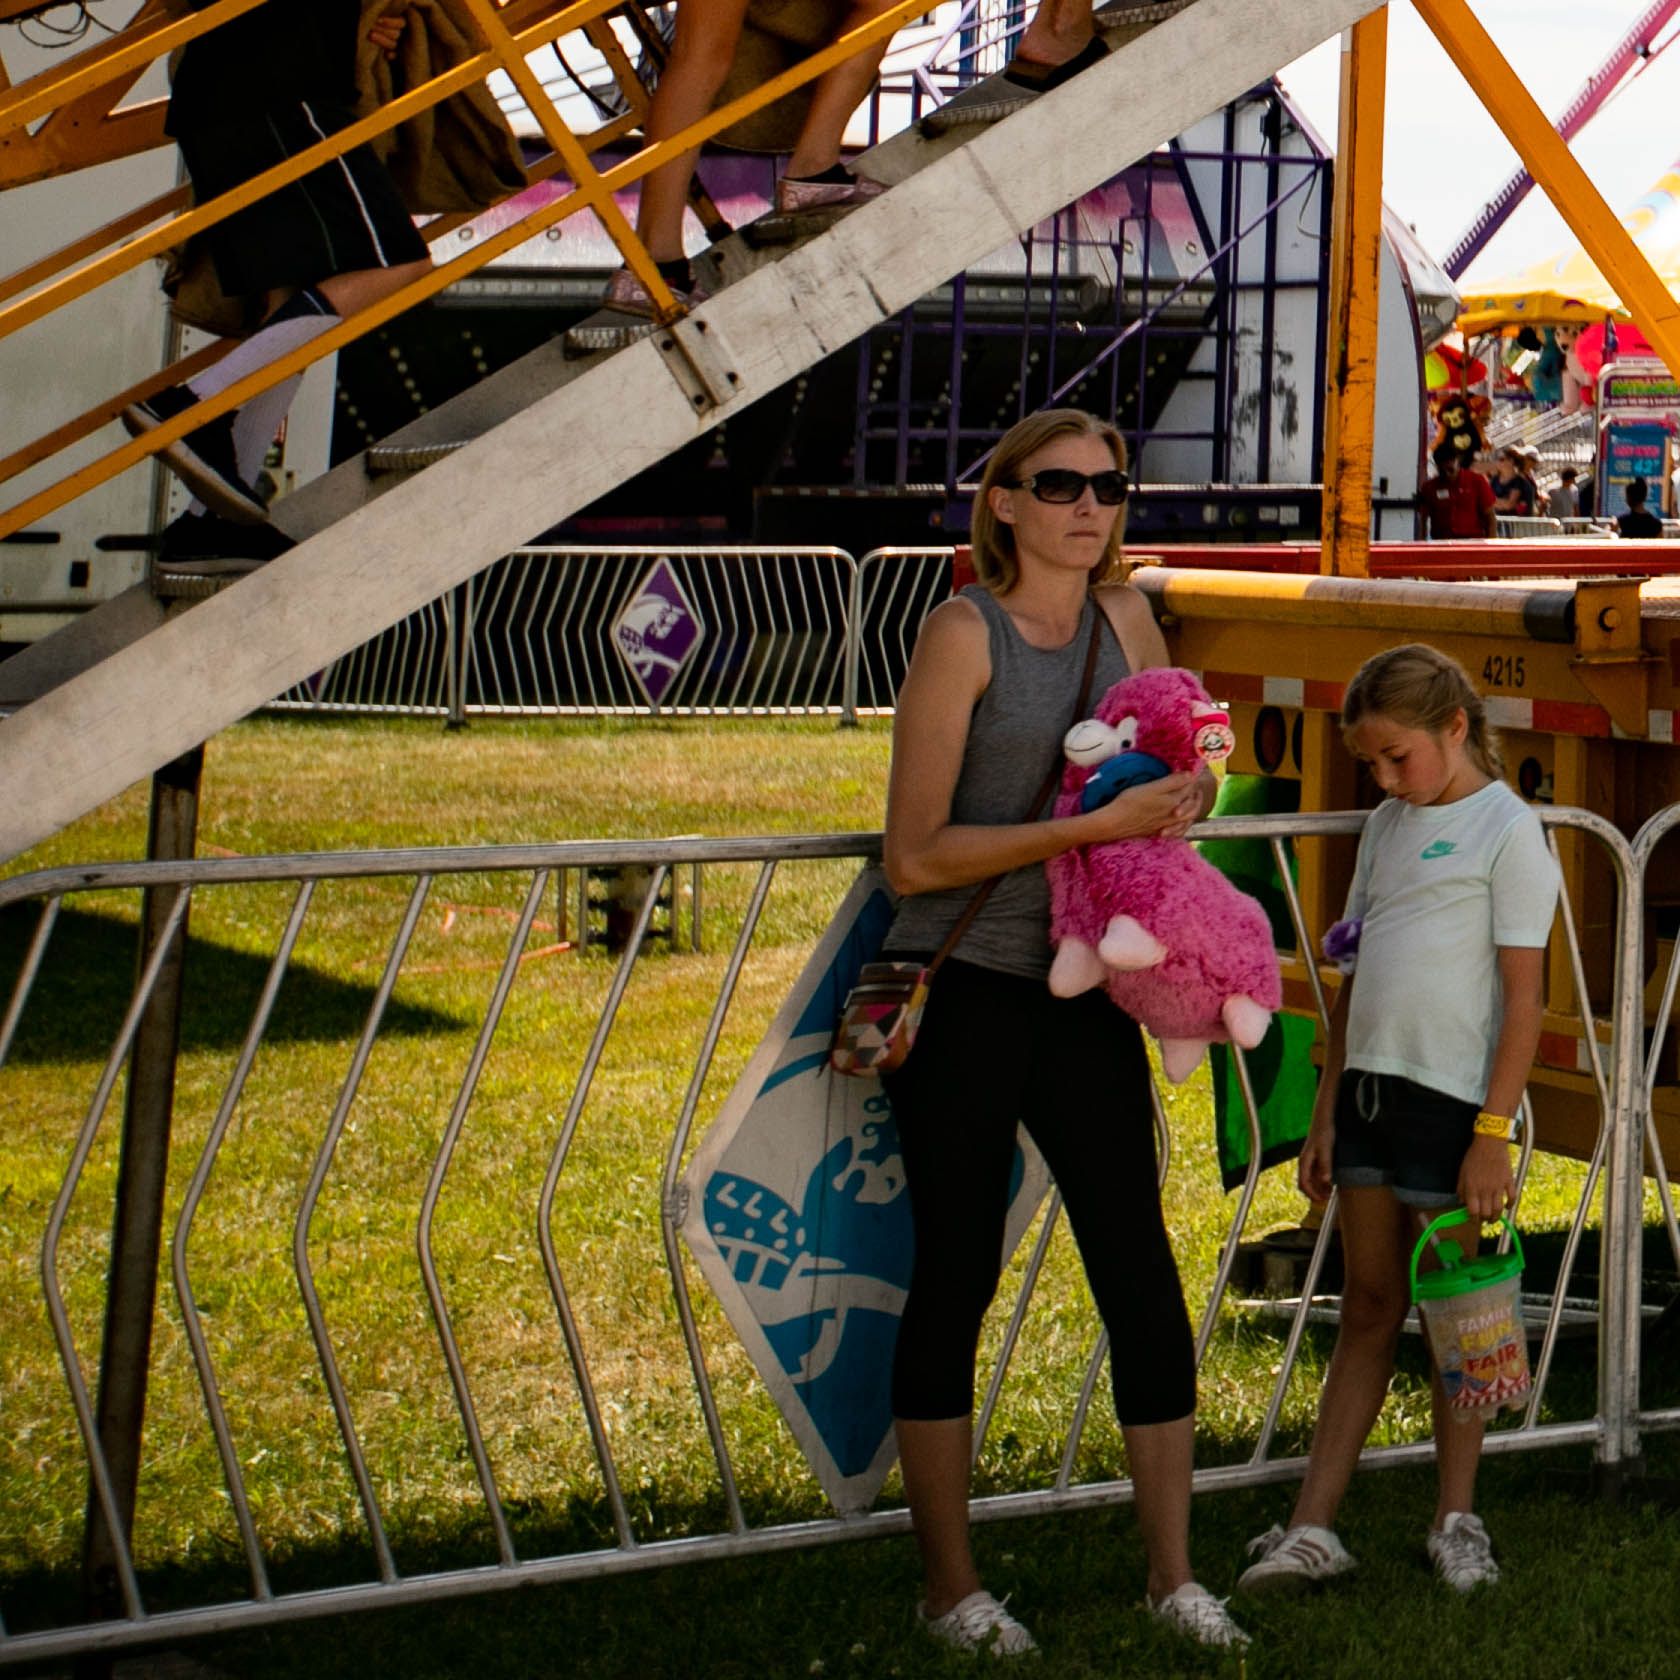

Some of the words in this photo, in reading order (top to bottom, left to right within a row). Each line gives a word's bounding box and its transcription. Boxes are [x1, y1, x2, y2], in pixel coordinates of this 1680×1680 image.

[1483, 656, 1525, 689] 4215
[1458, 1304, 1513, 1333] FAMILY
[1461, 1320, 1513, 1351] FUN
[1467, 1343, 1517, 1372] FAIR
